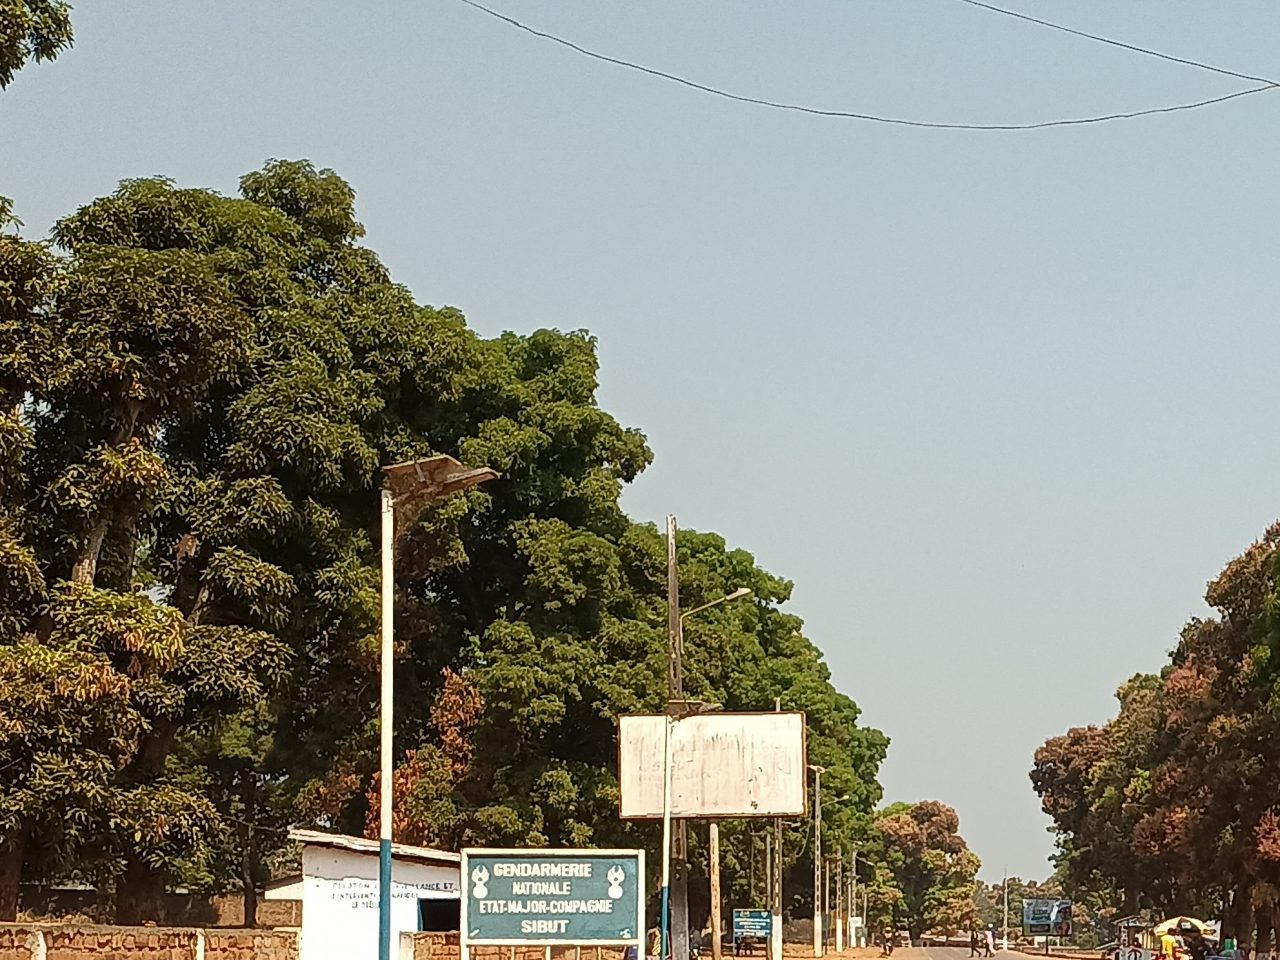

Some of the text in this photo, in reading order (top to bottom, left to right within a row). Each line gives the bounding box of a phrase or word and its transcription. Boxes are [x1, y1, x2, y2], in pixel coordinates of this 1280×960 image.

[494, 863, 592, 877] GENDARMERIE
[512, 881, 571, 895] NATIONALE
[521, 920, 569, 934] SIBUT
